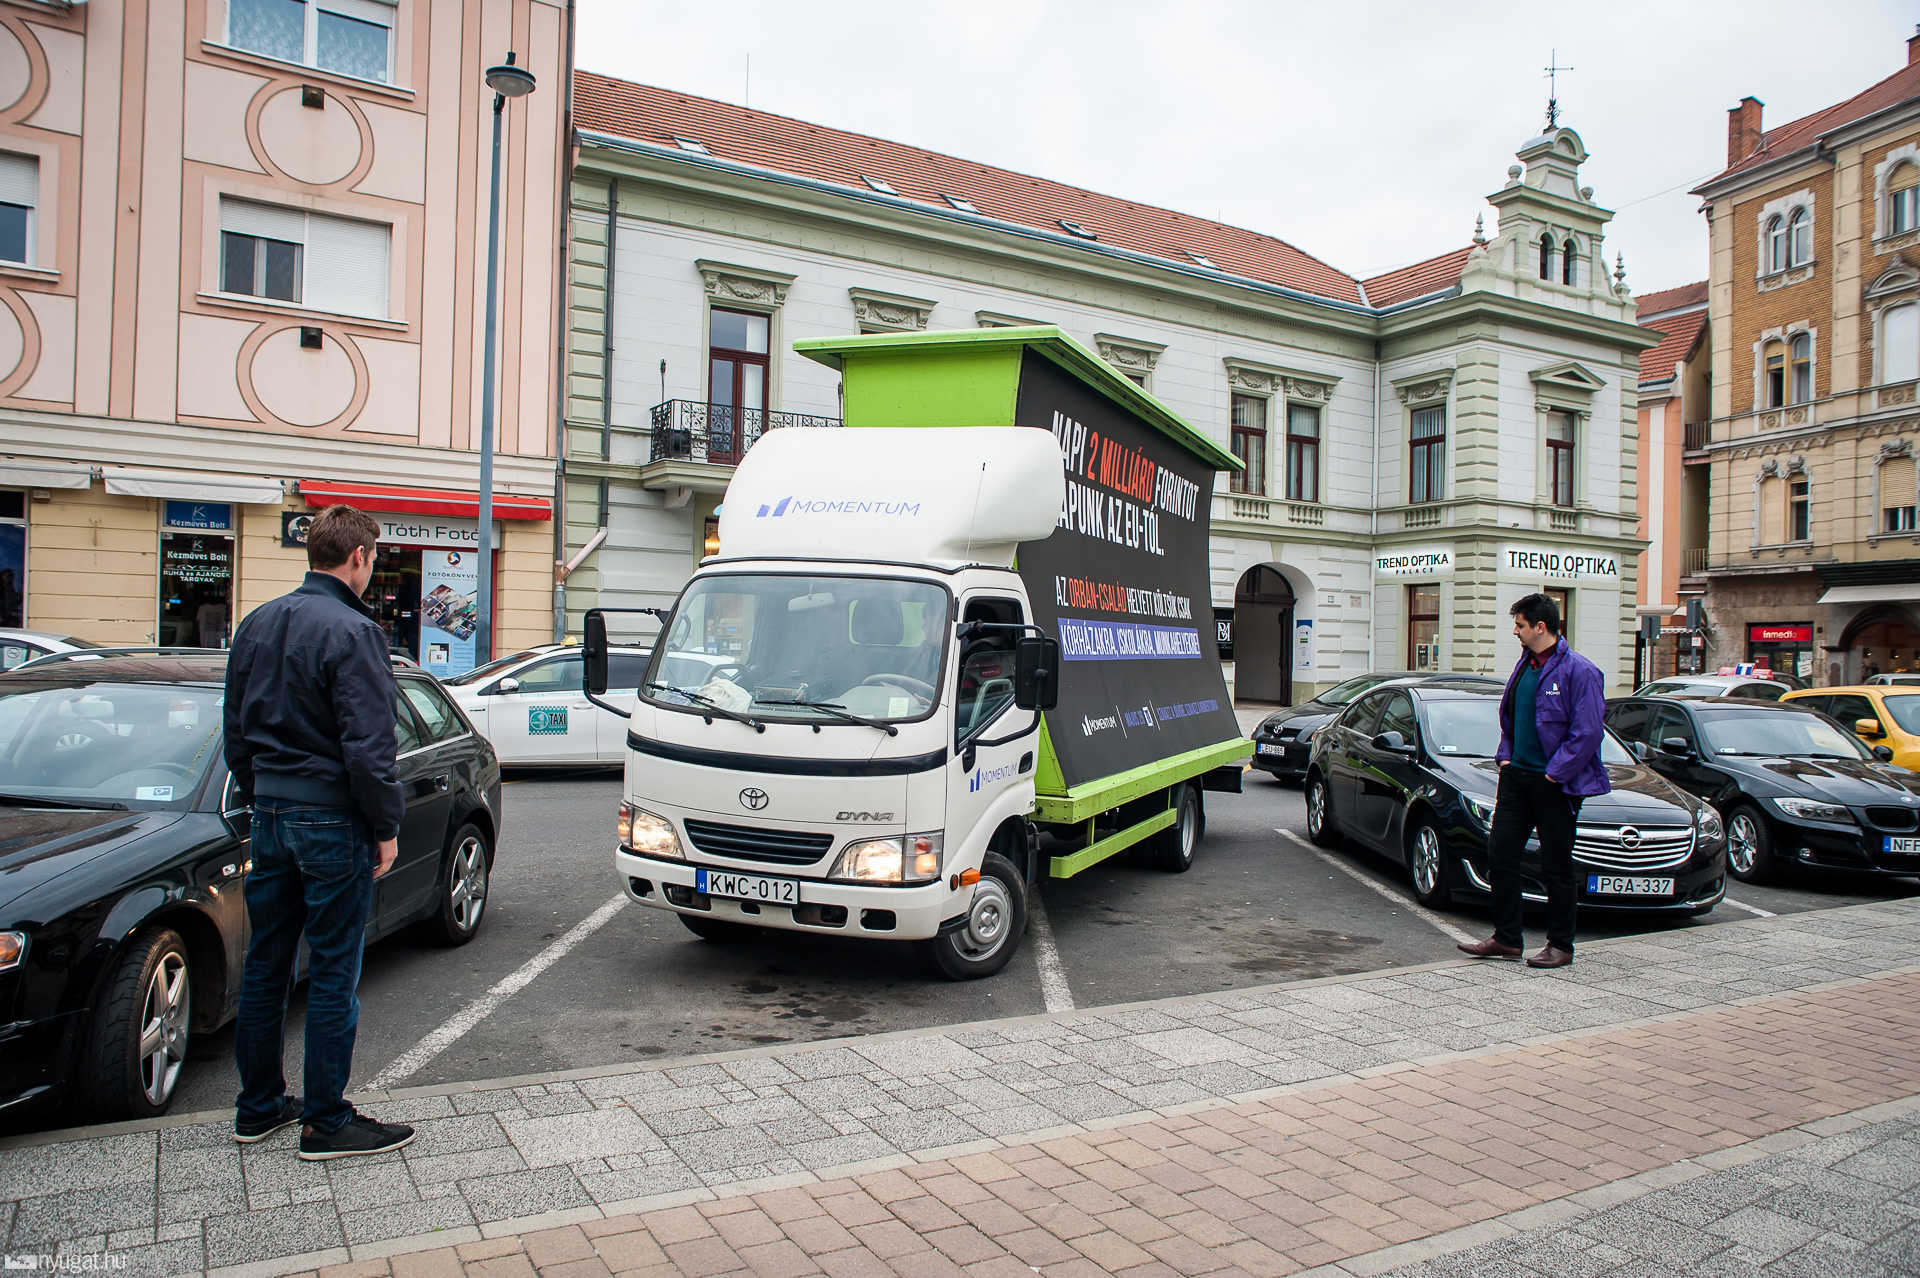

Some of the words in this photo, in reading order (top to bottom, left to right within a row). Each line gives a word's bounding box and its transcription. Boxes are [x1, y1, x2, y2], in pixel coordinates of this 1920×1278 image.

[1087, 431, 1099, 481] 2
[1099, 445, 1156, 503] MILLIÁRD
[1154, 465, 1200, 522] FORINTOT
[791, 499, 921, 517] MOMENTUM
[1056, 480, 1105, 540] APUNK
[1107, 495, 1123, 544] AZ
[1125, 503, 1165, 556] EU-TÓL.
[383, 521, 431, 538] Tóth
[434, 525, 479, 542] Fotó
[210, 552, 228, 561] Bolt
[1376, 556, 1409, 569] TREND
[1410, 553, 1449, 567] OPTIKA
[1508, 550, 1560, 571] TREND
[1563, 555, 1617, 576] OPTIKA
[1395, 567, 1434, 575] PALACE
[1055, 575, 1069, 606] AZ
[1068, 576, 1127, 613] ORBÁN-CSALÁD
[1126, 587, 1154, 616] HELYETT
[1176, 595, 1192, 619] CSAK
[1060, 619, 1119, 657] KÓRHÁZAKRA,
[1116, 624, 1157, 656] ISKOLÁKRA,
[549, 712, 567, 725] TAXI
[1088, 714, 1118, 732] MOMENTUM
[981, 762, 1018, 786] MOMENTUM
[835, 810, 895, 822] DYNA
[709, 873, 794, 902] KWC-012
[1599, 877, 1672, 895] PGA-337
